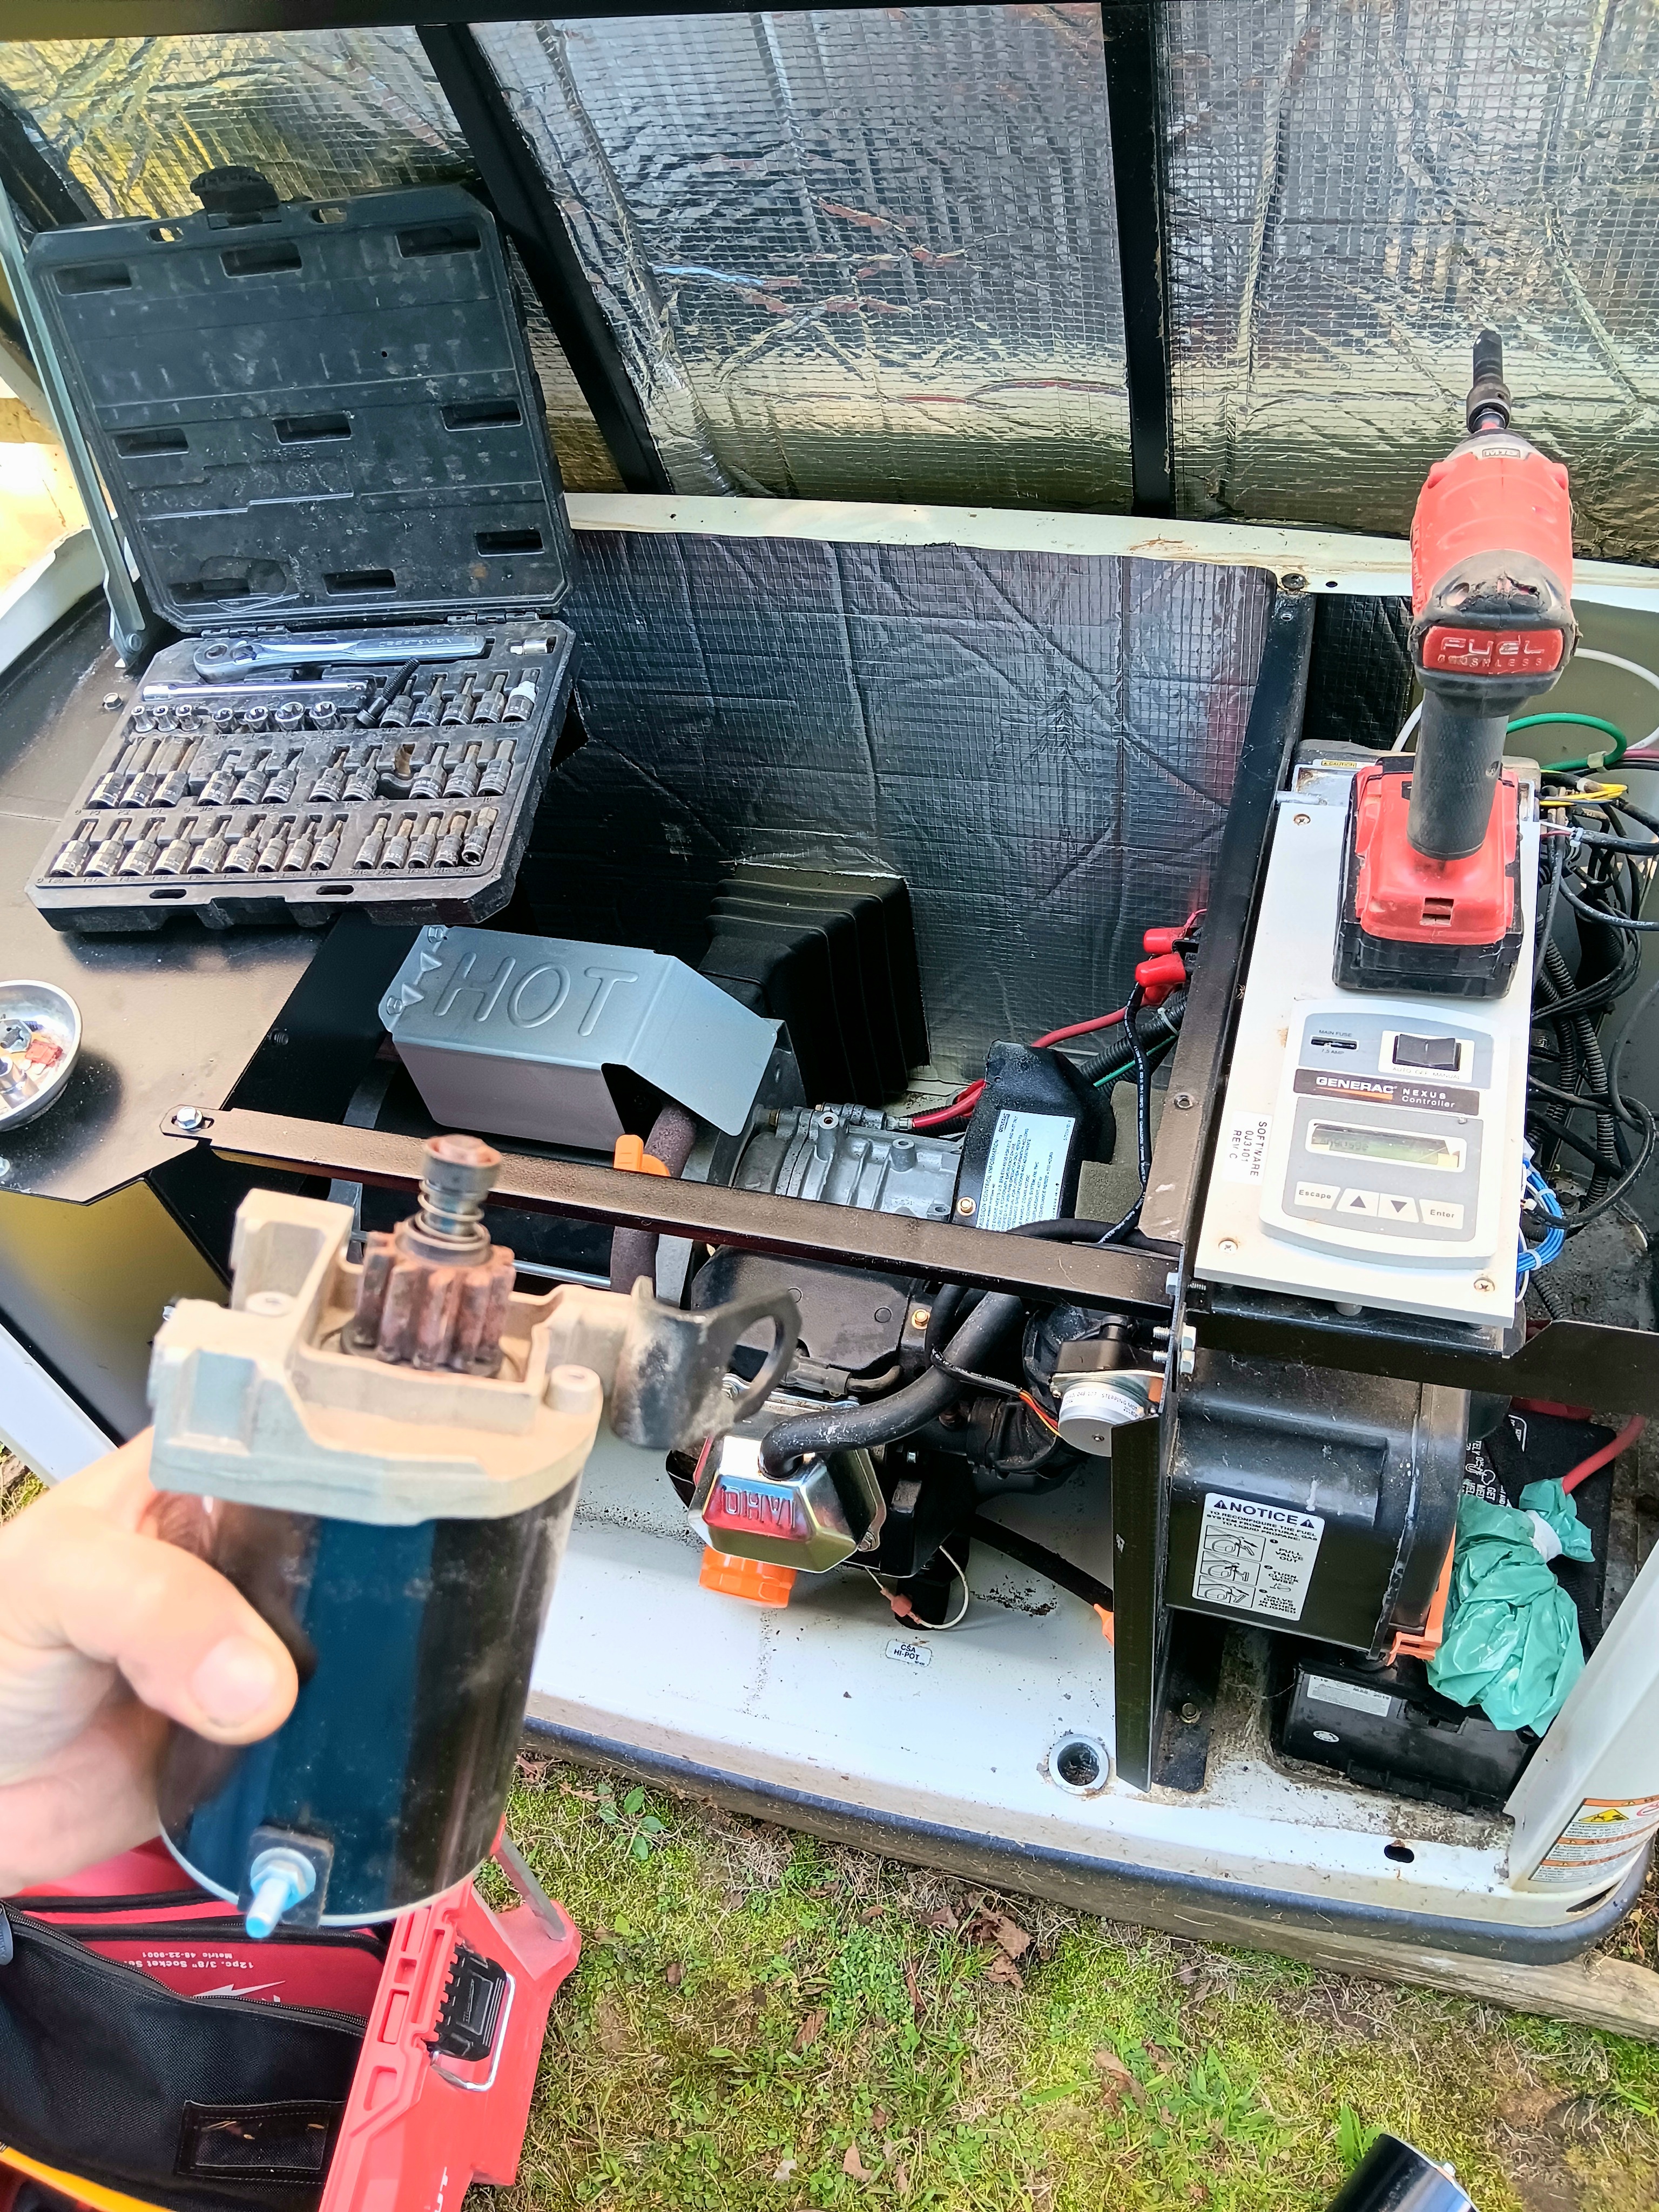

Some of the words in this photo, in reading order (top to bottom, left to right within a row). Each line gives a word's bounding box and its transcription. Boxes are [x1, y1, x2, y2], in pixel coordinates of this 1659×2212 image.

[1441, 635, 1544, 655] FUEL
[434, 952, 639, 1037] HOT
[1316, 1076, 1395, 1094] GENERAC
[1402, 1088, 1446, 1100] NEXUS
[1401, 1095, 1455, 1108] Controller
[1232, 1130, 1242, 1149] REV
[1250, 1122, 1267, 1176] SOFTWARE
[977, 1203, 987, 1227] MISSION
[982, 1174, 992, 1201] CONTROL
[988, 1139, 999, 1173] INFORMATION
[1299, 1189, 1331, 1200] Escape
[1430, 1209, 1455, 1218] Enter
[1102, 1393, 1127, 1405] STEPPING
[1486, 1487, 1496, 1501] GET
[1230, 1502, 1298, 1526] NOTICE
[1206, 1514, 1237, 1523] SYSTEM
[1263, 1526, 1299, 1537] NATURAL
[1222, 1513, 1277, 1528] RECONFIGURE
[1234, 1523, 1259, 1532] LIQUID
[1275, 1551, 1303, 1561] VALVE
[1279, 1548, 1301, 1556] PULL
[1269, 1573, 1299, 1583] CLOCK
[1264, 1598, 1293, 1607] DROPS
[1266, 1595, 1293, 1603] VALVE
[1258, 1603, 1296, 1614] ALIGNED
[1270, 1602, 1296, 1611] WHEN
[901, 1644, 915, 1653] CSA
[894, 1649, 920, 1660] HI-POT
[221, 1961, 254, 1969] 12pc.
